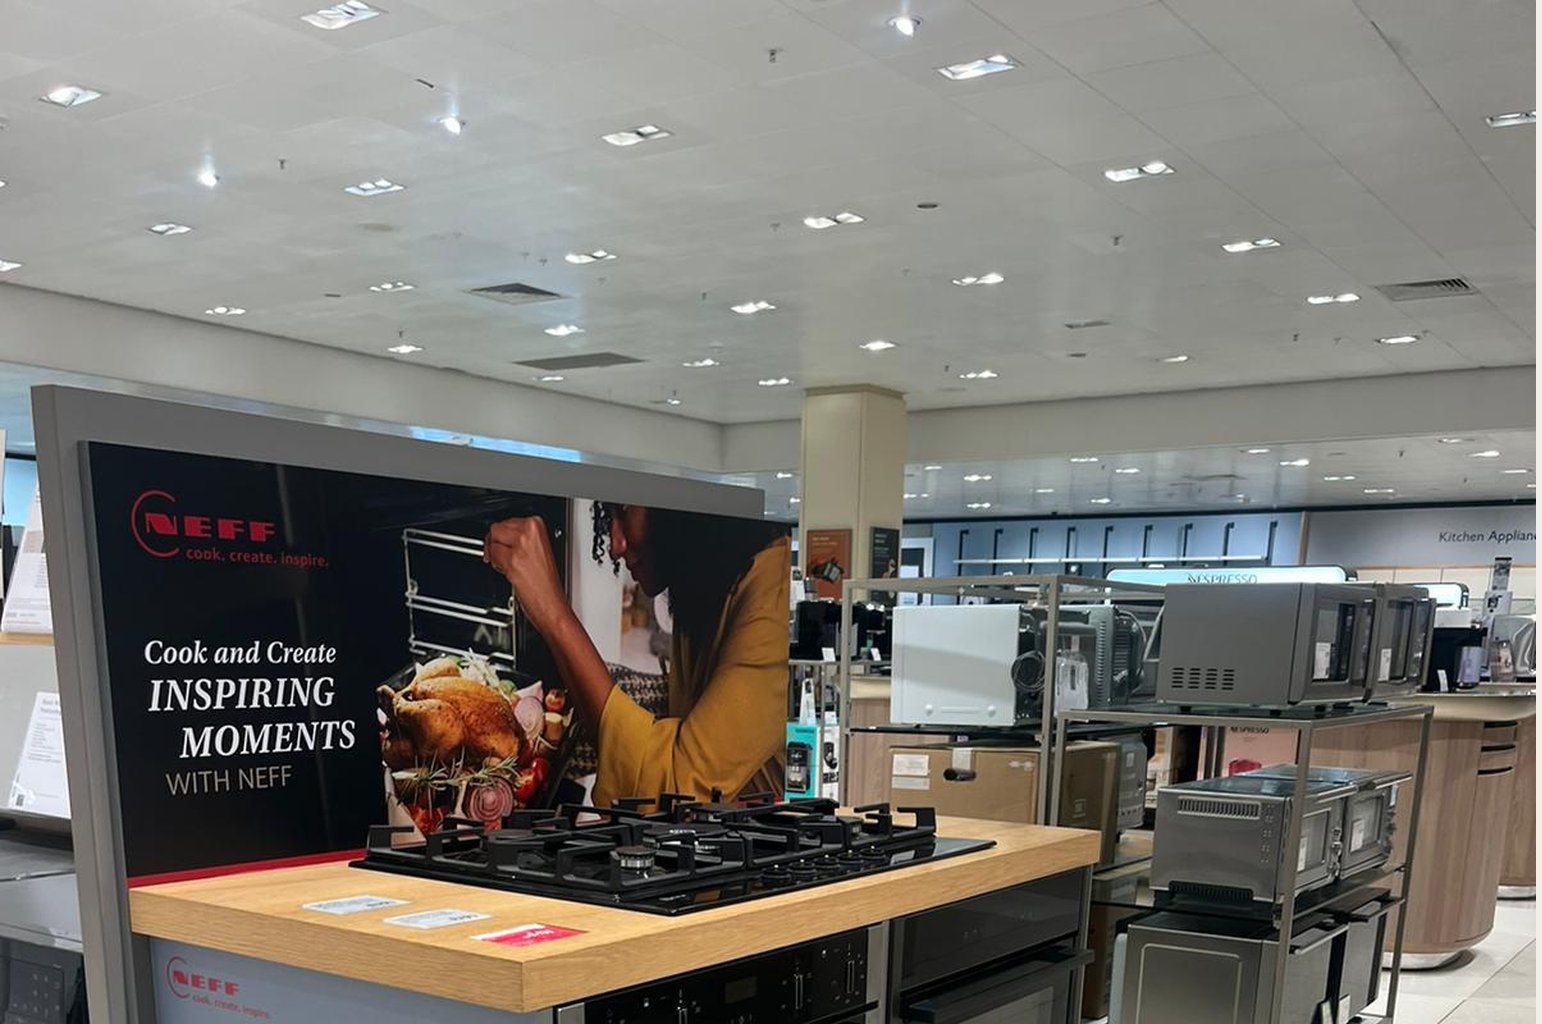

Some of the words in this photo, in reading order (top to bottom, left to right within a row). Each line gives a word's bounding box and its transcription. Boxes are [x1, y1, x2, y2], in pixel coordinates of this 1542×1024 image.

[1438, 531, 1485, 542] Kitchen
[186, 547, 225, 562] cook.
[229, 551, 278, 564] create.
[281, 555, 329, 568] inspire.
[144, 640, 208, 664] Cook
[213, 641, 261, 663] and
[267, 641, 337, 664] Create
[148, 676, 335, 711] INSPIRING
[179, 719, 356, 758] MOMENTS
[165, 768, 230, 796] WITH
[238, 765, 292, 790] NEFF
